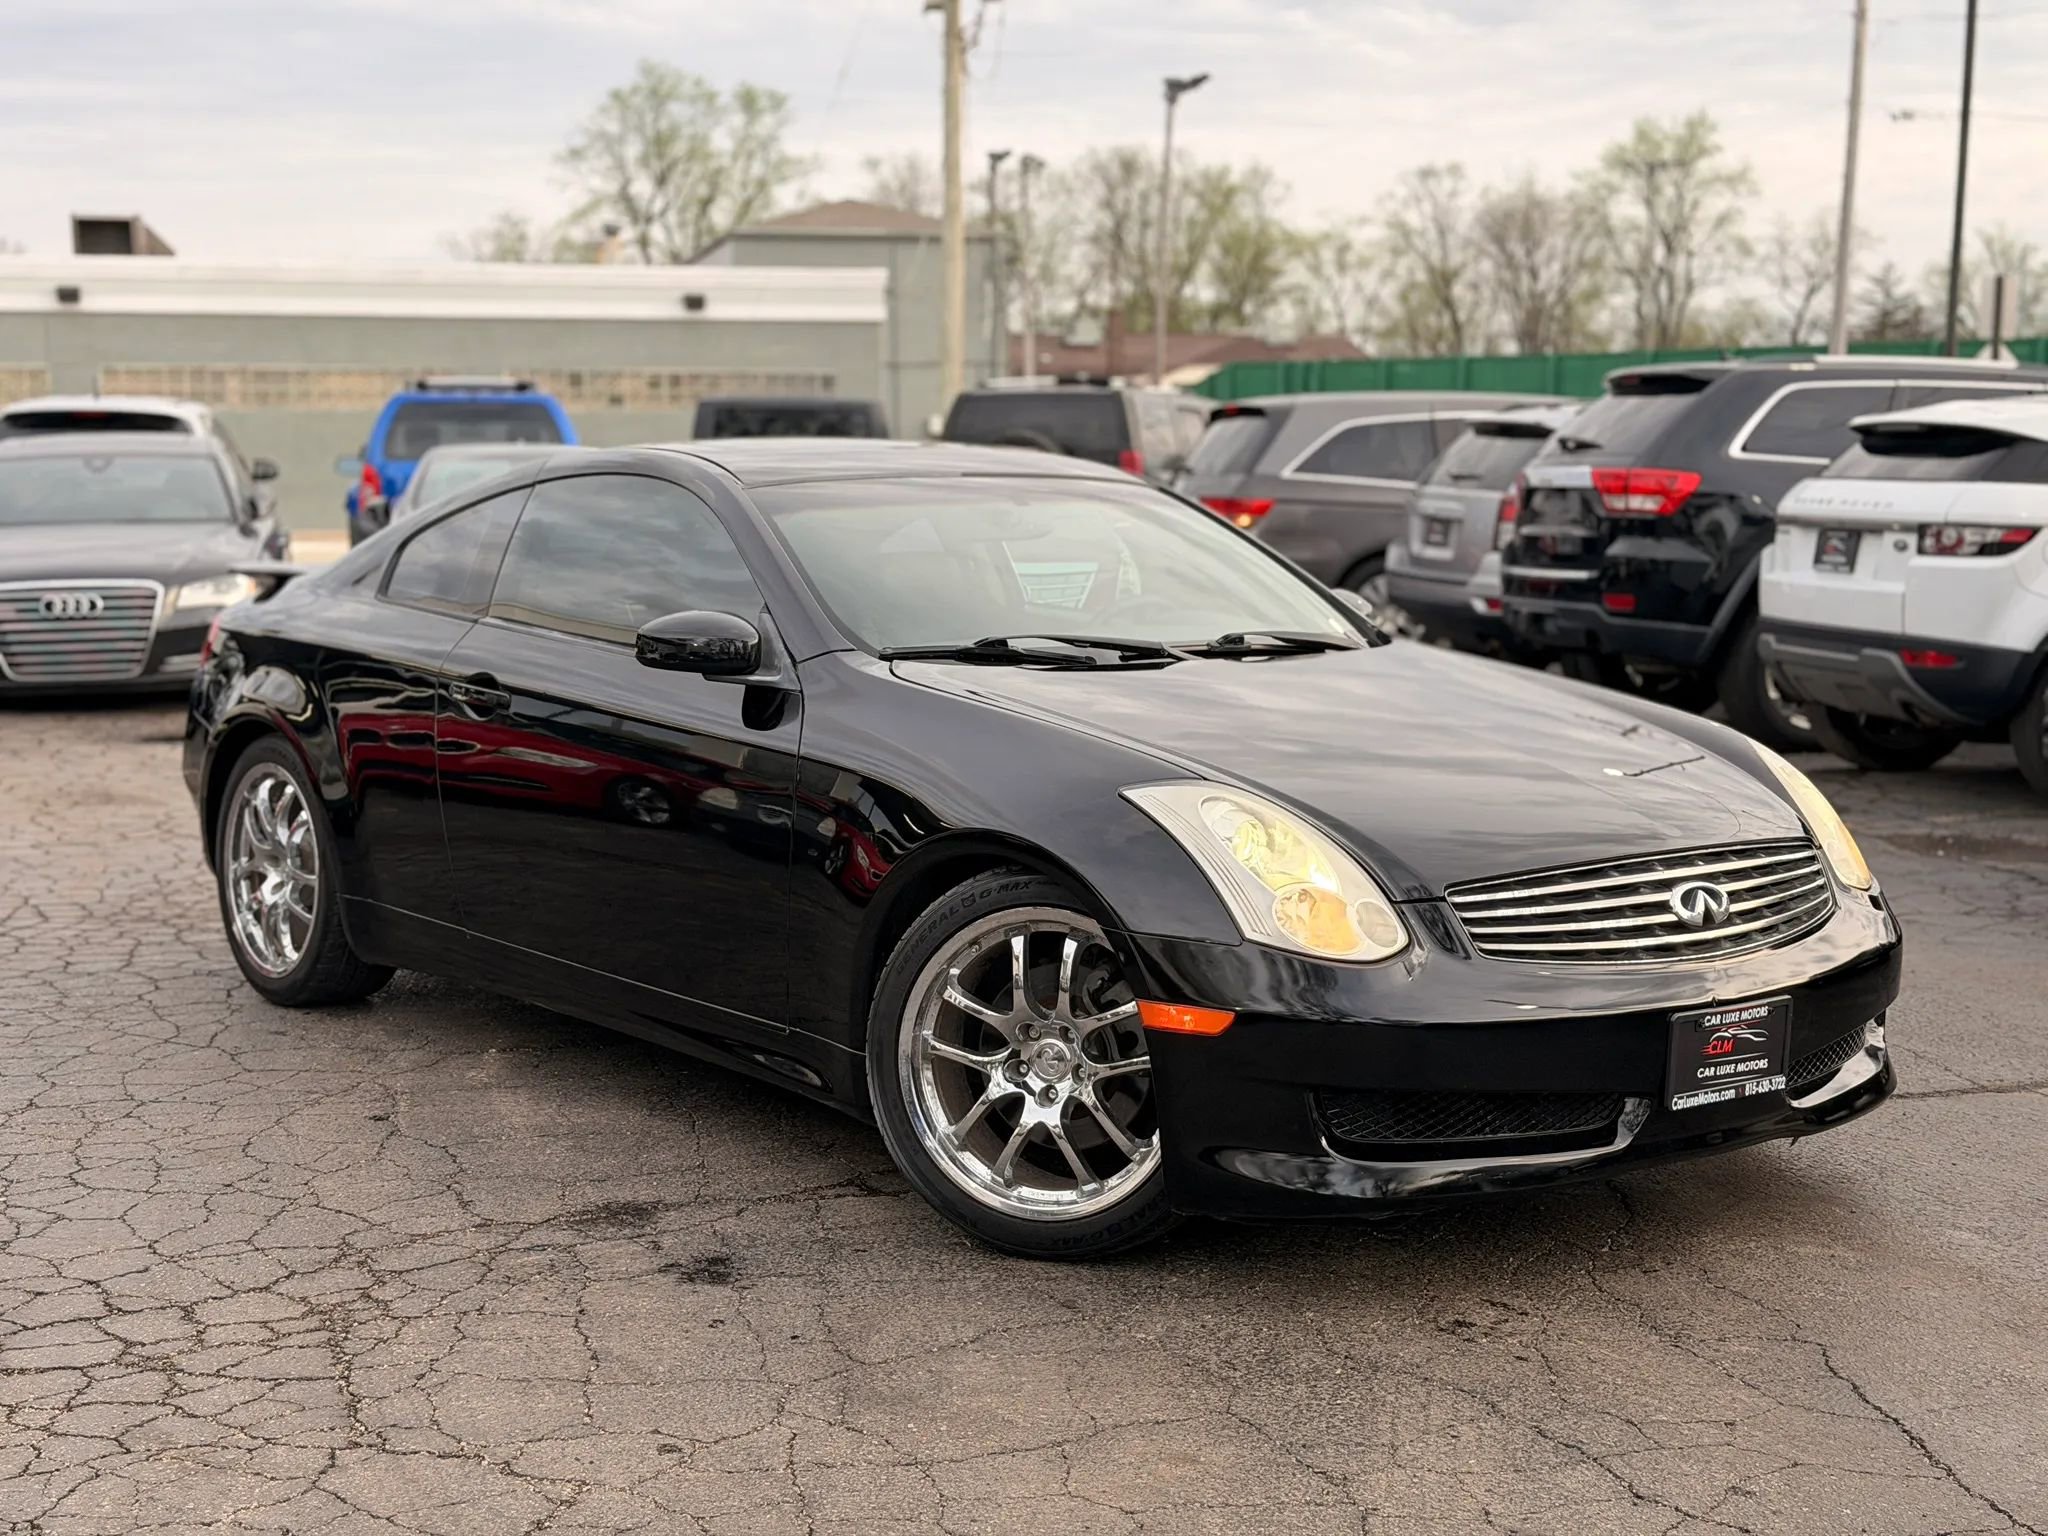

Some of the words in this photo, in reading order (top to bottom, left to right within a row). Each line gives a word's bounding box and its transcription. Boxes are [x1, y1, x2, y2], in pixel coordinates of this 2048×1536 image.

[897, 906, 960, 974] GENERAL
[1704, 1013, 1721, 1026] CAR
[1722, 1011, 1740, 1023] LUXE
[1740, 1006, 1769, 1020] MOTORS
[1709, 1039, 1734, 1054] CLM
[1697, 1066, 1715, 1078] CAR
[1716, 1063, 1736, 1075] LUXE
[1736, 1059, 1769, 1073] MOTORS
[1672, 1088, 1736, 1111] CarLuxeMotors.com
[1745, 1077, 1786, 1096] 815-630-3722
